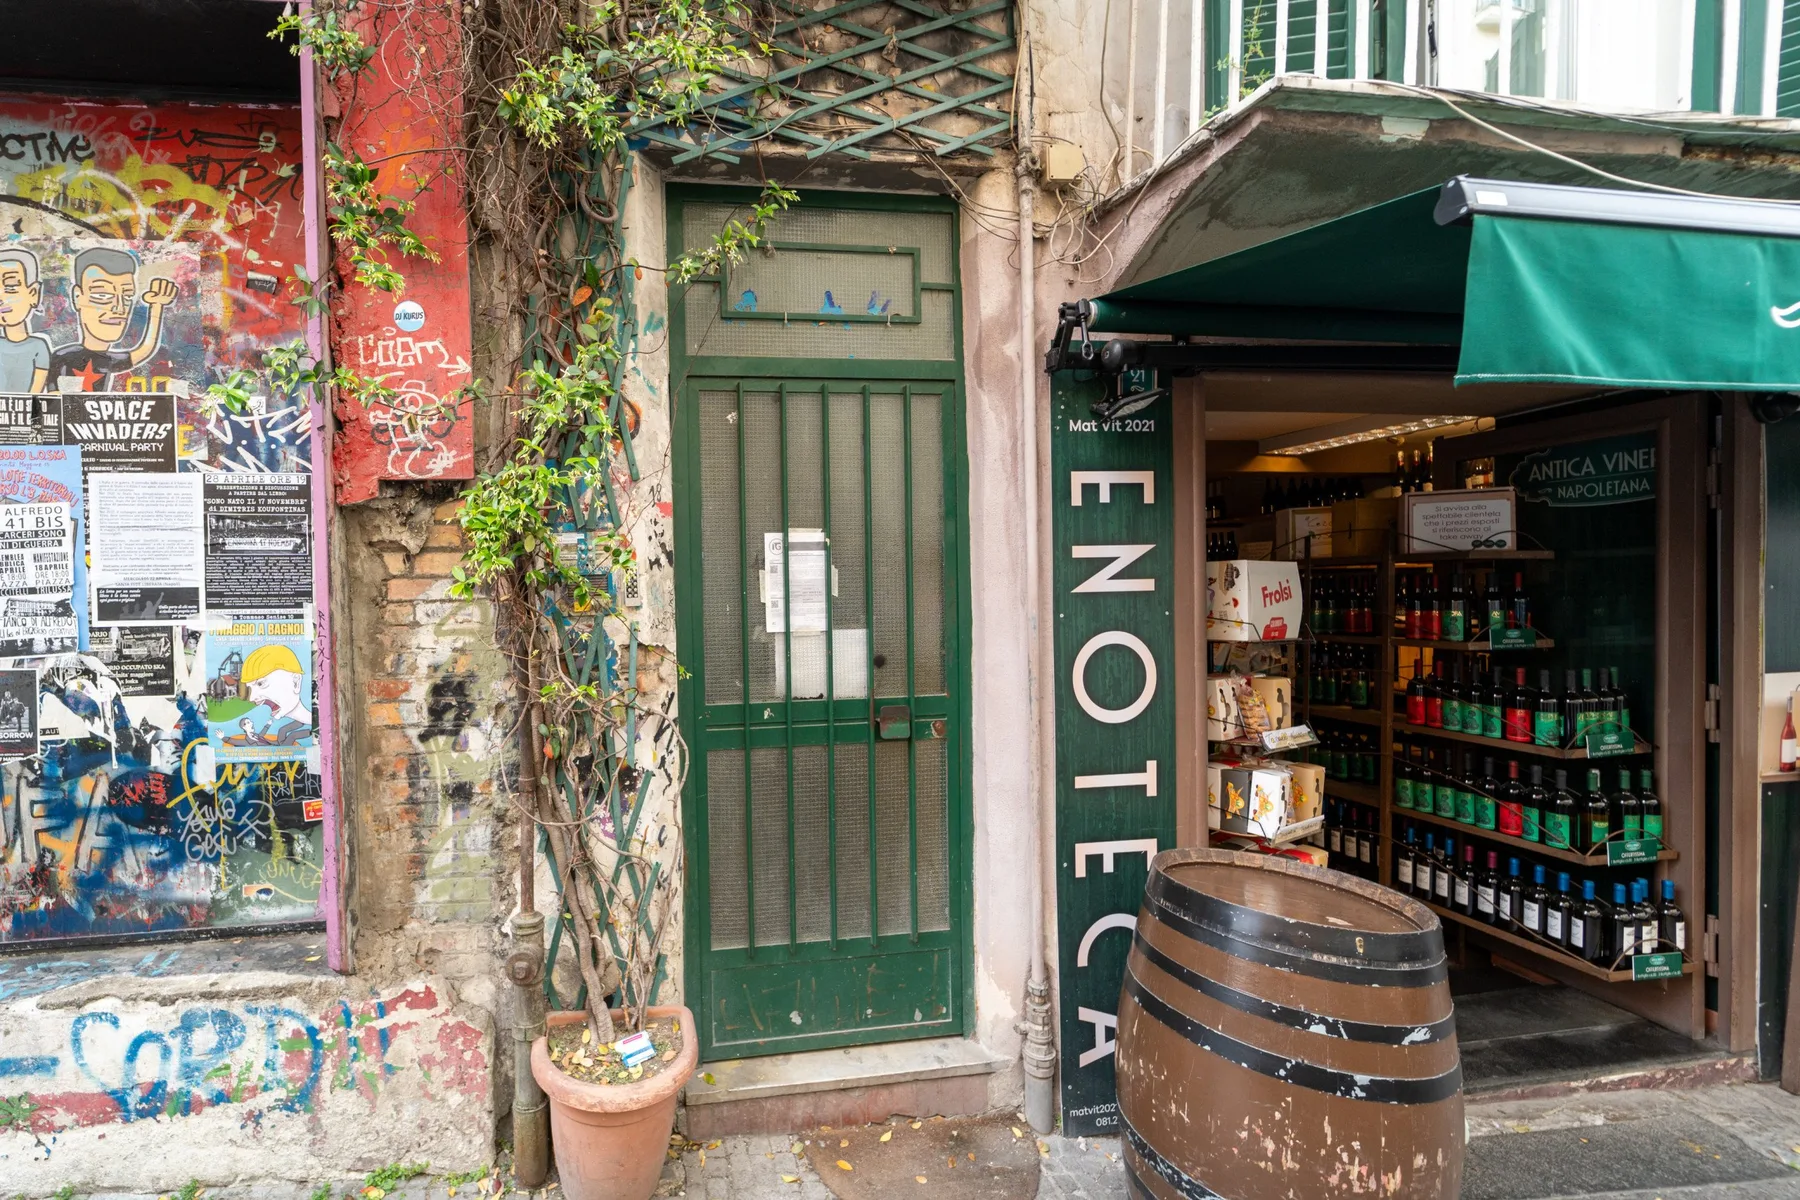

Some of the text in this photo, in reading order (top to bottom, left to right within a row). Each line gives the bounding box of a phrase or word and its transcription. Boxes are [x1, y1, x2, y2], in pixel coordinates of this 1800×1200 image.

[394, 311, 424, 321] DJ KURUS
[15, 399, 24, 412] LO
[85, 400, 156, 421] SPACE
[17, 412, 25, 425] IL
[66, 423, 173, 440] INVADERS
[1069, 419, 1155, 432] Mat vit 2021
[78, 443, 164, 452] CARNIVAL PARTY
[1529, 456, 1595, 482] ANTICA
[206, 474, 306, 483] 28 APRILE ORE 19
[1557, 478, 1650, 499] NAPOLETANA
[5, 506, 62, 516] ALFREDO
[1422, 510, 1501, 520] spettabile clientela
[5, 516, 63, 529] 41 BIS
[1445, 519, 1468, 527] prezzi
[38, 530, 63, 538] SONO
[24, 540, 59, 548] GUERRA
[44, 563, 69, 571] APRILE
[34, 571, 48, 579] ORE
[51, 570, 70, 578] 18:00
[35, 578, 71, 587] PIAZZA
[1261, 579, 1293, 608] Frolsi
[258, 623, 265, 636] A
[267, 623, 304, 636] BAGNOL
[1071, 470, 1158, 1068] ENOTECA
[1070, 1102, 1117, 1117] matvit202
